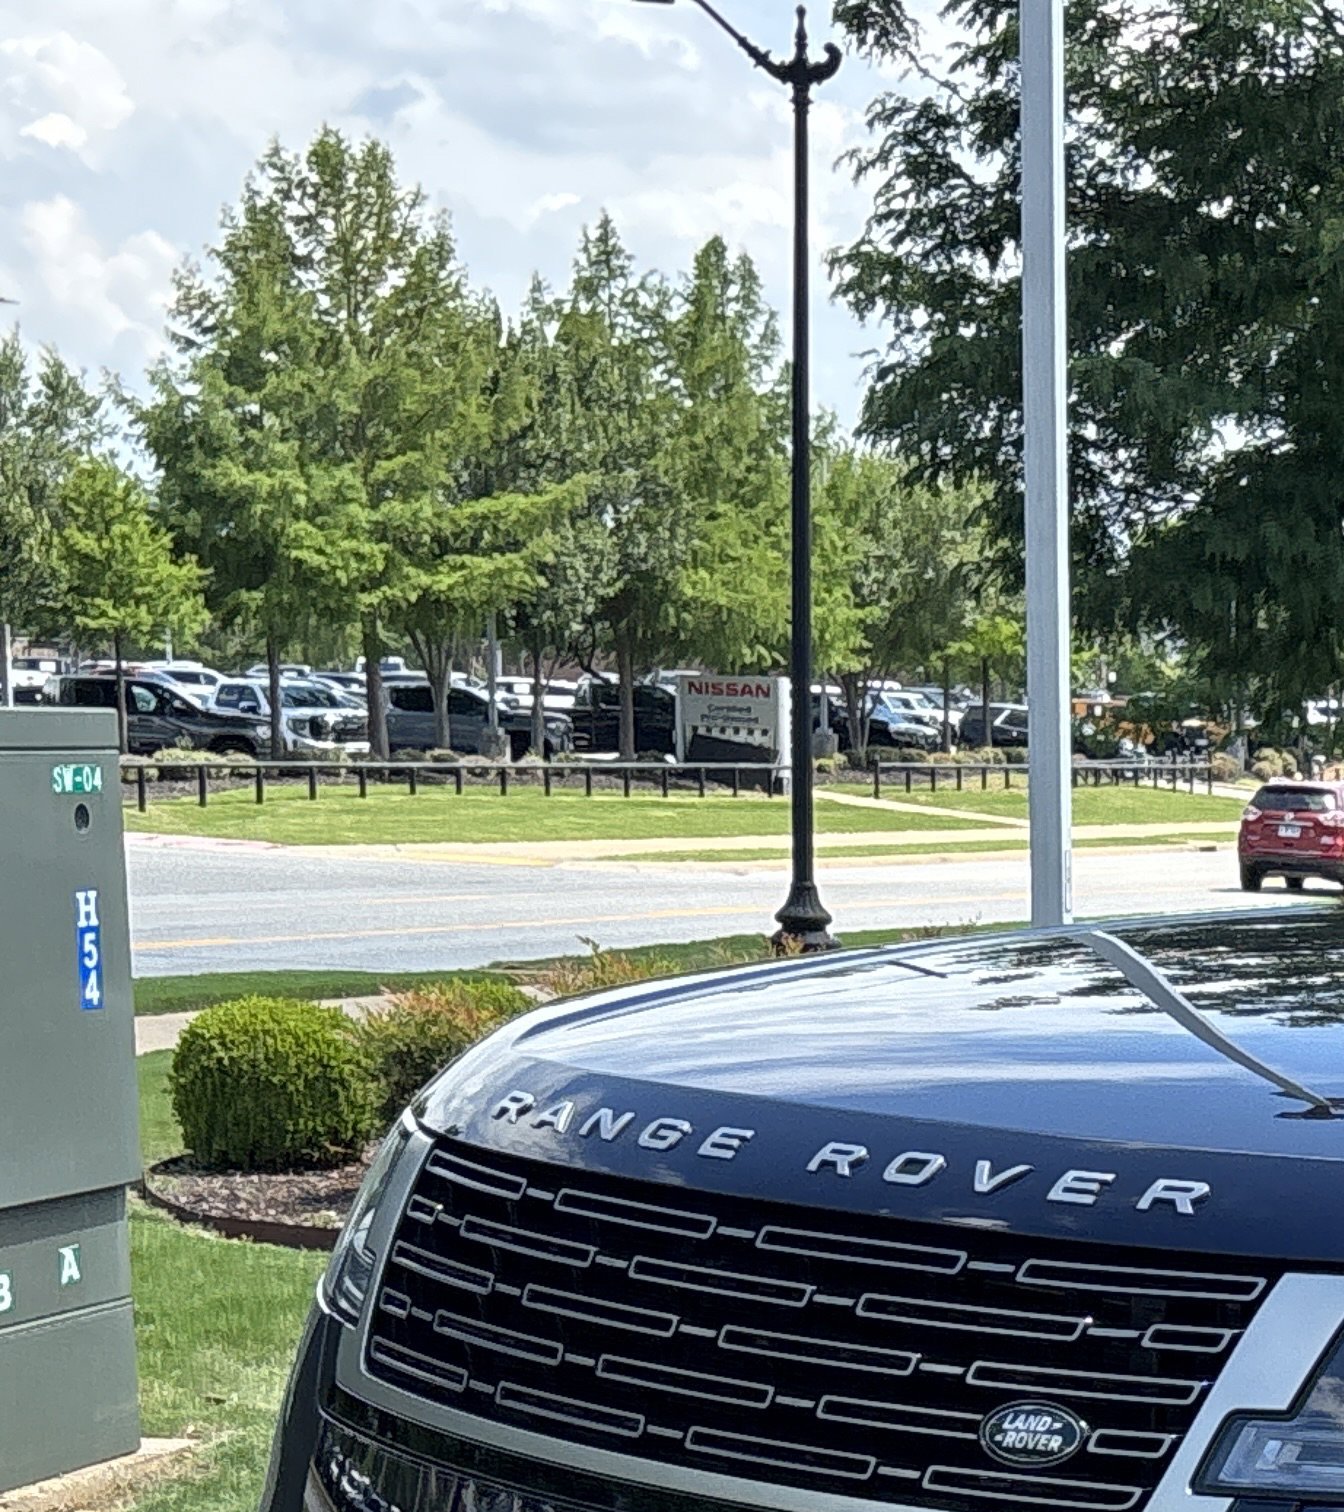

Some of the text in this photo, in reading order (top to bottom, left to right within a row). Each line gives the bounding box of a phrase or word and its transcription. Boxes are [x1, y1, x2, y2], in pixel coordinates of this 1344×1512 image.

[688, 681, 770, 697] NISSAN
[53, 766, 102, 792] SW-04
[491, 1090, 1211, 1214] RANGE ROVER
[58, 1243, 80, 1284] A
[1002, 1413, 1052, 1431] LAND
[1002, 1432, 1063, 1452] ROVER
